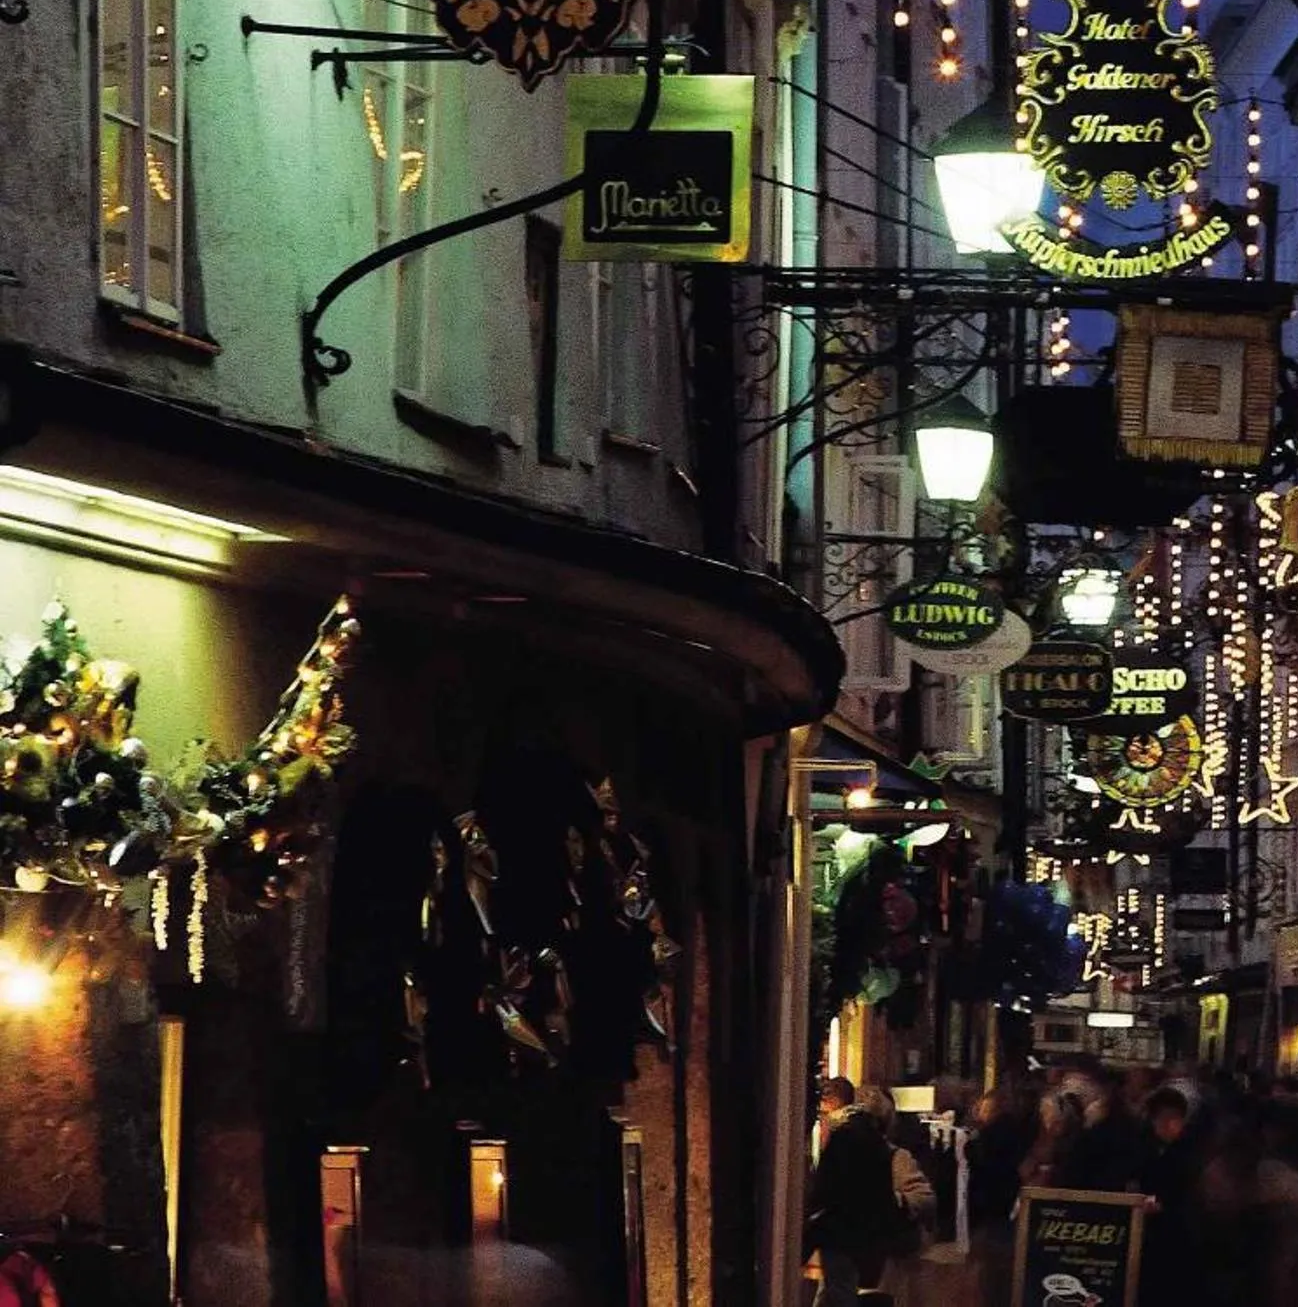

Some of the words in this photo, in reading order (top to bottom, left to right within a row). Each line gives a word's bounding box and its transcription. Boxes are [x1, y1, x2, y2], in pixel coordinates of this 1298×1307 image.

[1066, 63, 1177, 92] Goldener
[1067, 115, 1166, 144] Hirsch
[590, 177, 724, 234] Marietta
[892, 603, 995, 625] LUDWIG
[1111, 666, 1188, 694] SCHO
